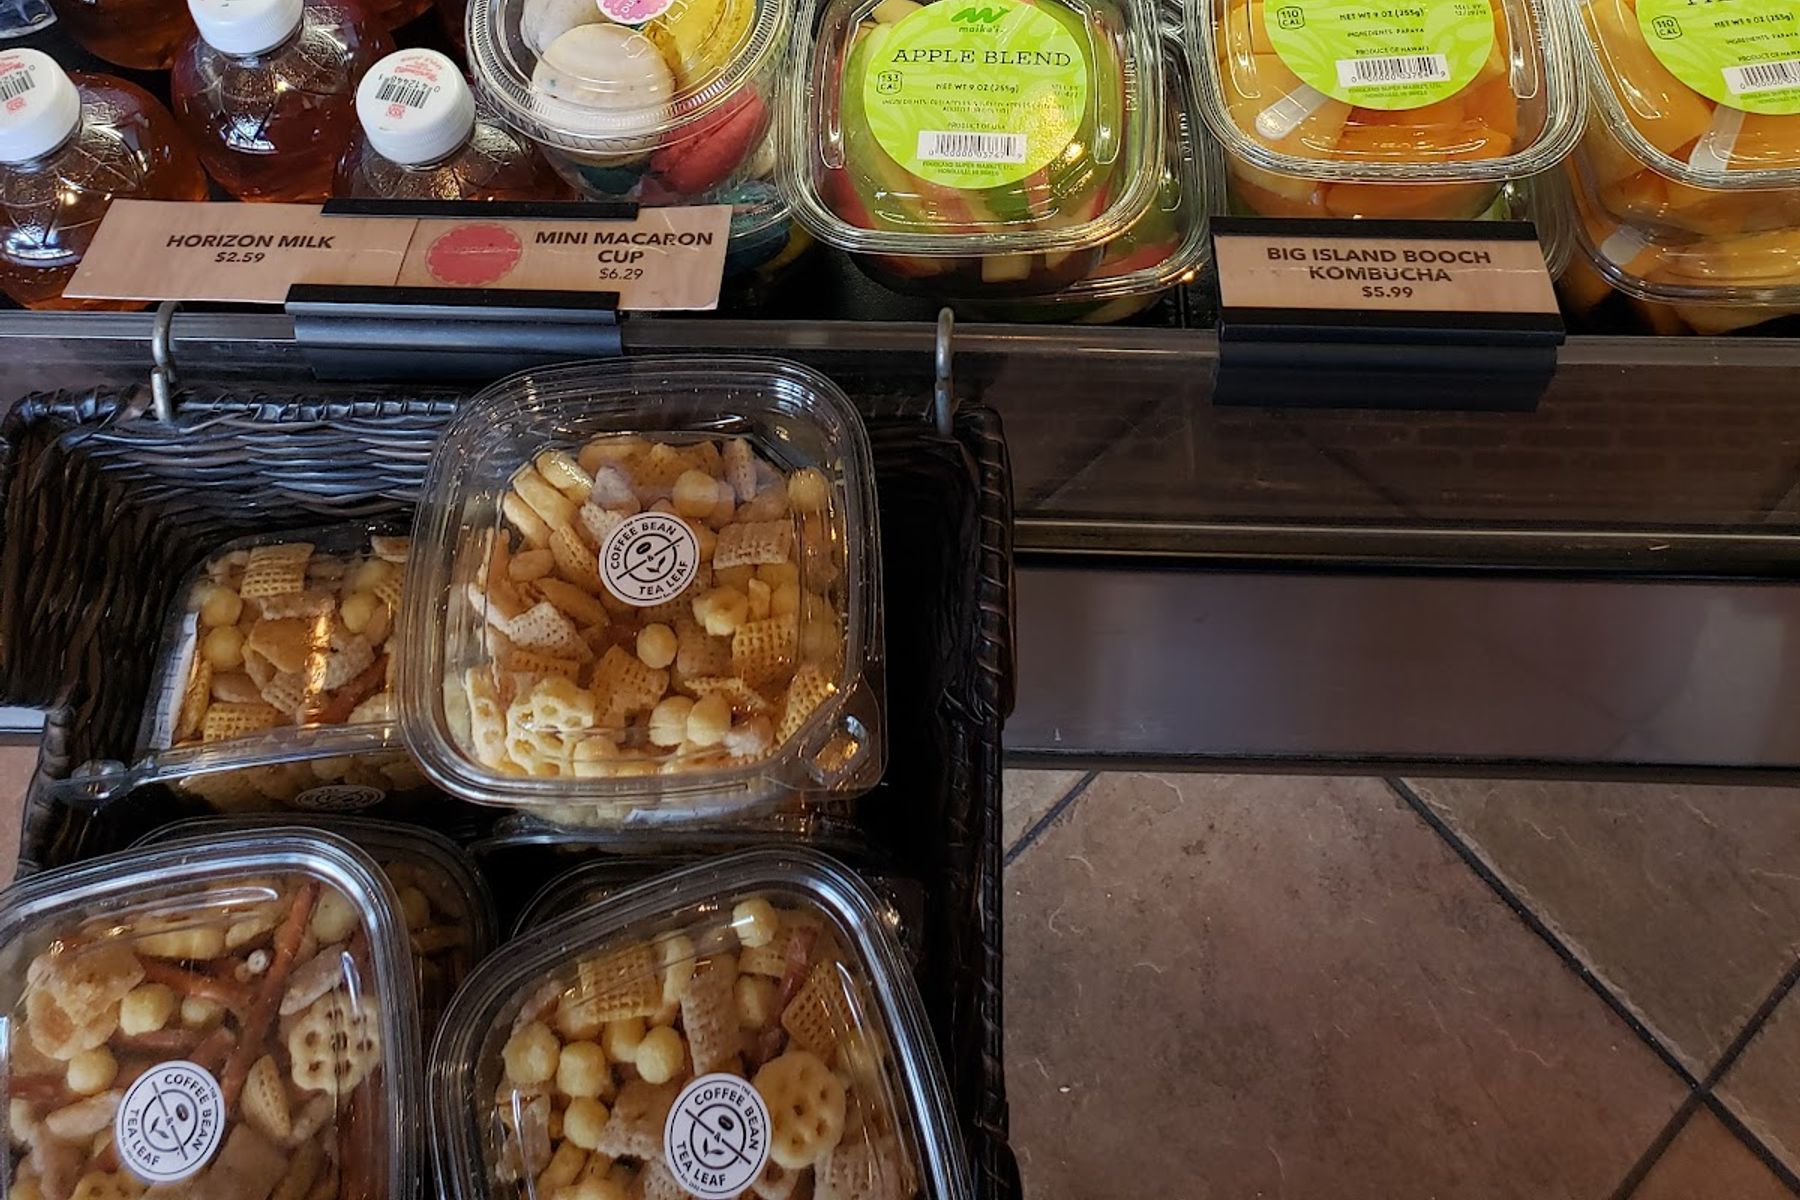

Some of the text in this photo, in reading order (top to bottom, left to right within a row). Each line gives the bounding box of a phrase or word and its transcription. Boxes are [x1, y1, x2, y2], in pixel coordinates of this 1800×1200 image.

[891, 49, 1071, 66] APPLE BLEND
[166, 234, 335, 249] HORIZON MILK
[535, 231, 713, 246] MINI MACARON
[214, 252, 266, 263] $2.59
[598, 250, 644, 264] CUP
[1267, 247, 1491, 264] BIG ISLAND BOOCH
[599, 268, 643, 281] $6.29
[1309, 266, 1453, 283] KOMBUCHA
[1362, 286, 1414, 299] $5.99
[611, 522, 677, 570] COFFEE BEAN
[639, 560, 688, 595] TEA LEAF
[164, 1074, 212, 1151] COFFEE BEAN
[694, 1087, 759, 1151] COFFEE BEAN
[128, 1108, 160, 1166] TEA LEAF
[677, 1141, 726, 1186] TEA LEAF
